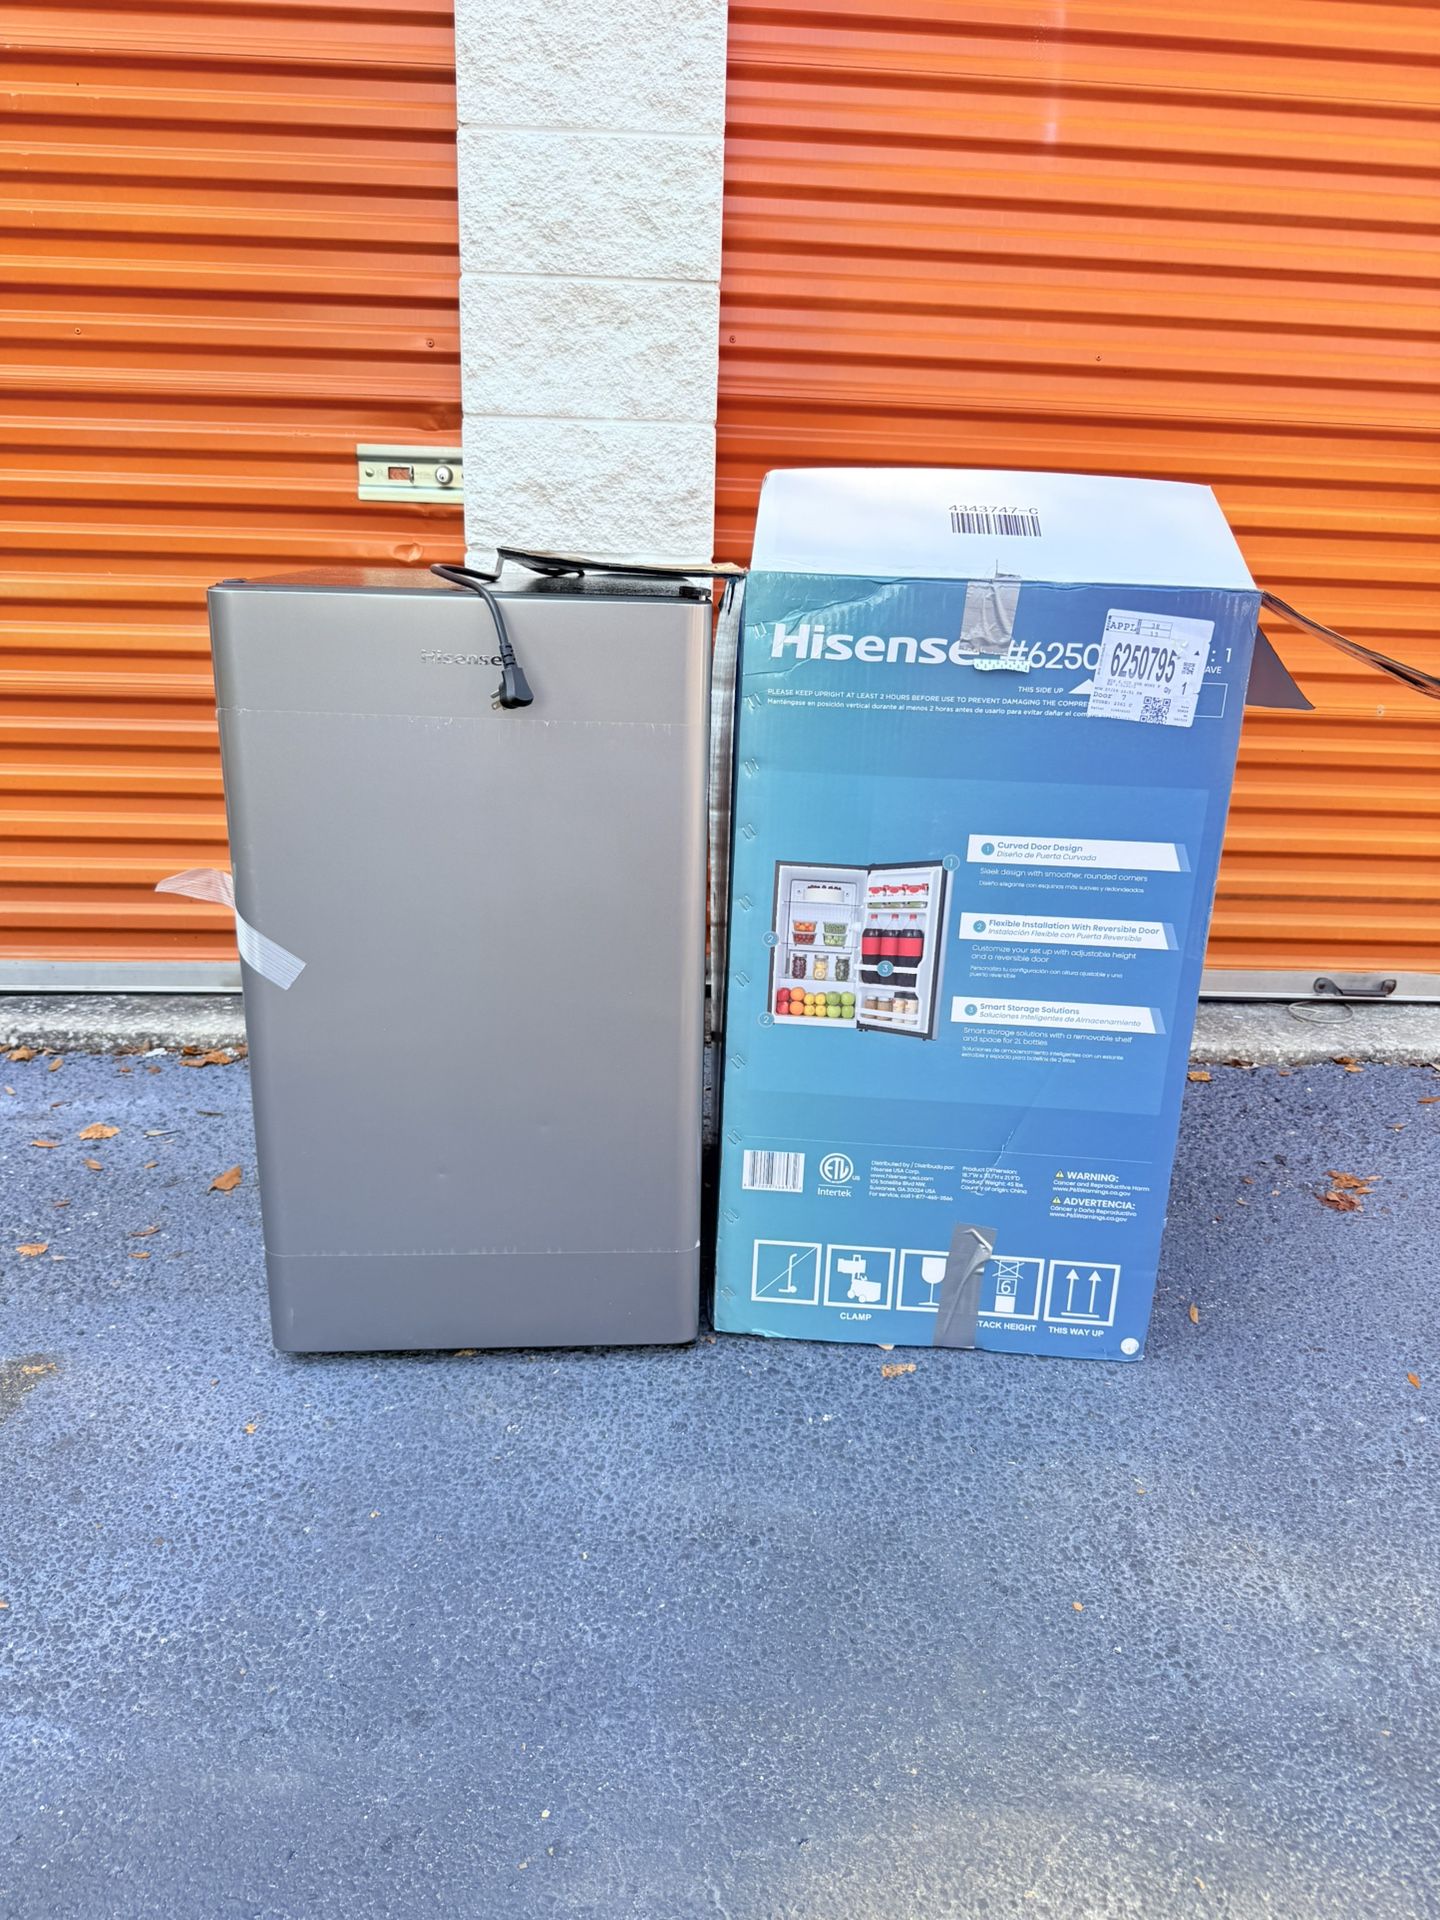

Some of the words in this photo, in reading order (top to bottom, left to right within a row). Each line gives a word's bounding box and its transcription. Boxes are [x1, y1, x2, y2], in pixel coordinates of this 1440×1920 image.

[948, 505, 1038, 514] 4343747-C
[1110, 622, 1136, 632] APPL
[771, 623, 979, 666] Hisense
[420, 649, 502, 666] Hisense
[1110, 642, 1177, 683] 6250795
[1182, 682, 1187, 696] 1
[768, 698, 806, 707] Manténgase
[817, 700, 844, 709] posición
[871, 702, 896, 710] durante
[1002, 698, 1040, 706] DAMAGING
[1057, 700, 1089, 708] COMPRE
[998, 842, 1028, 850] Curved
[1053, 844, 1083, 853] Design
[997, 850, 1023, 858] Diseño
[1036, 852, 1061, 860] Puerta
[1063, 853, 1097, 861] Curvada
[1001, 869, 1026, 877] design
[1022, 921, 1070, 930] Installation
[1093, 925, 1136, 934] Reversible
[988, 928, 1030, 936] Instalación
[1103, 934, 1142, 942] Reversible
[995, 954, 1030, 962] reversible
[1071, 950, 1111, 958] adjustable
[1112, 952, 1136, 960] height
[882, 964, 889, 972] 3
[1007, 1004, 1040, 1013] Storage
[1042, 1006, 1080, 1015] Solutions
[1021, 1014, 1063, 1022] Inteligentes
[1075, 1016, 1141, 1027] Almacenamiento
[987, 1028, 1015, 1037] storage
[1016, 1030, 1048, 1038] solutions
[1073, 1034, 1113, 1042] removable
[1023, 1038, 1048, 1046] bottles
[824, 1157, 849, 1180] ETL
[1067, 1171, 1119, 1182] WARNING:
[818, 1187, 852, 1197] Intertek
[1063, 1197, 1136, 1210] ADVERTENCIA:
[1096, 1209, 1137, 1217] Reproductivo
[1001, 1280, 1011, 1294] 6
[840, 1312, 872, 1320] CLAMP
[1004, 1322, 1037, 1332] HEIGHT
[1048, 1326, 1068, 1334] THIS
[1070, 1328, 1090, 1336] WAY
[1092, 1329, 1104, 1337] UP
